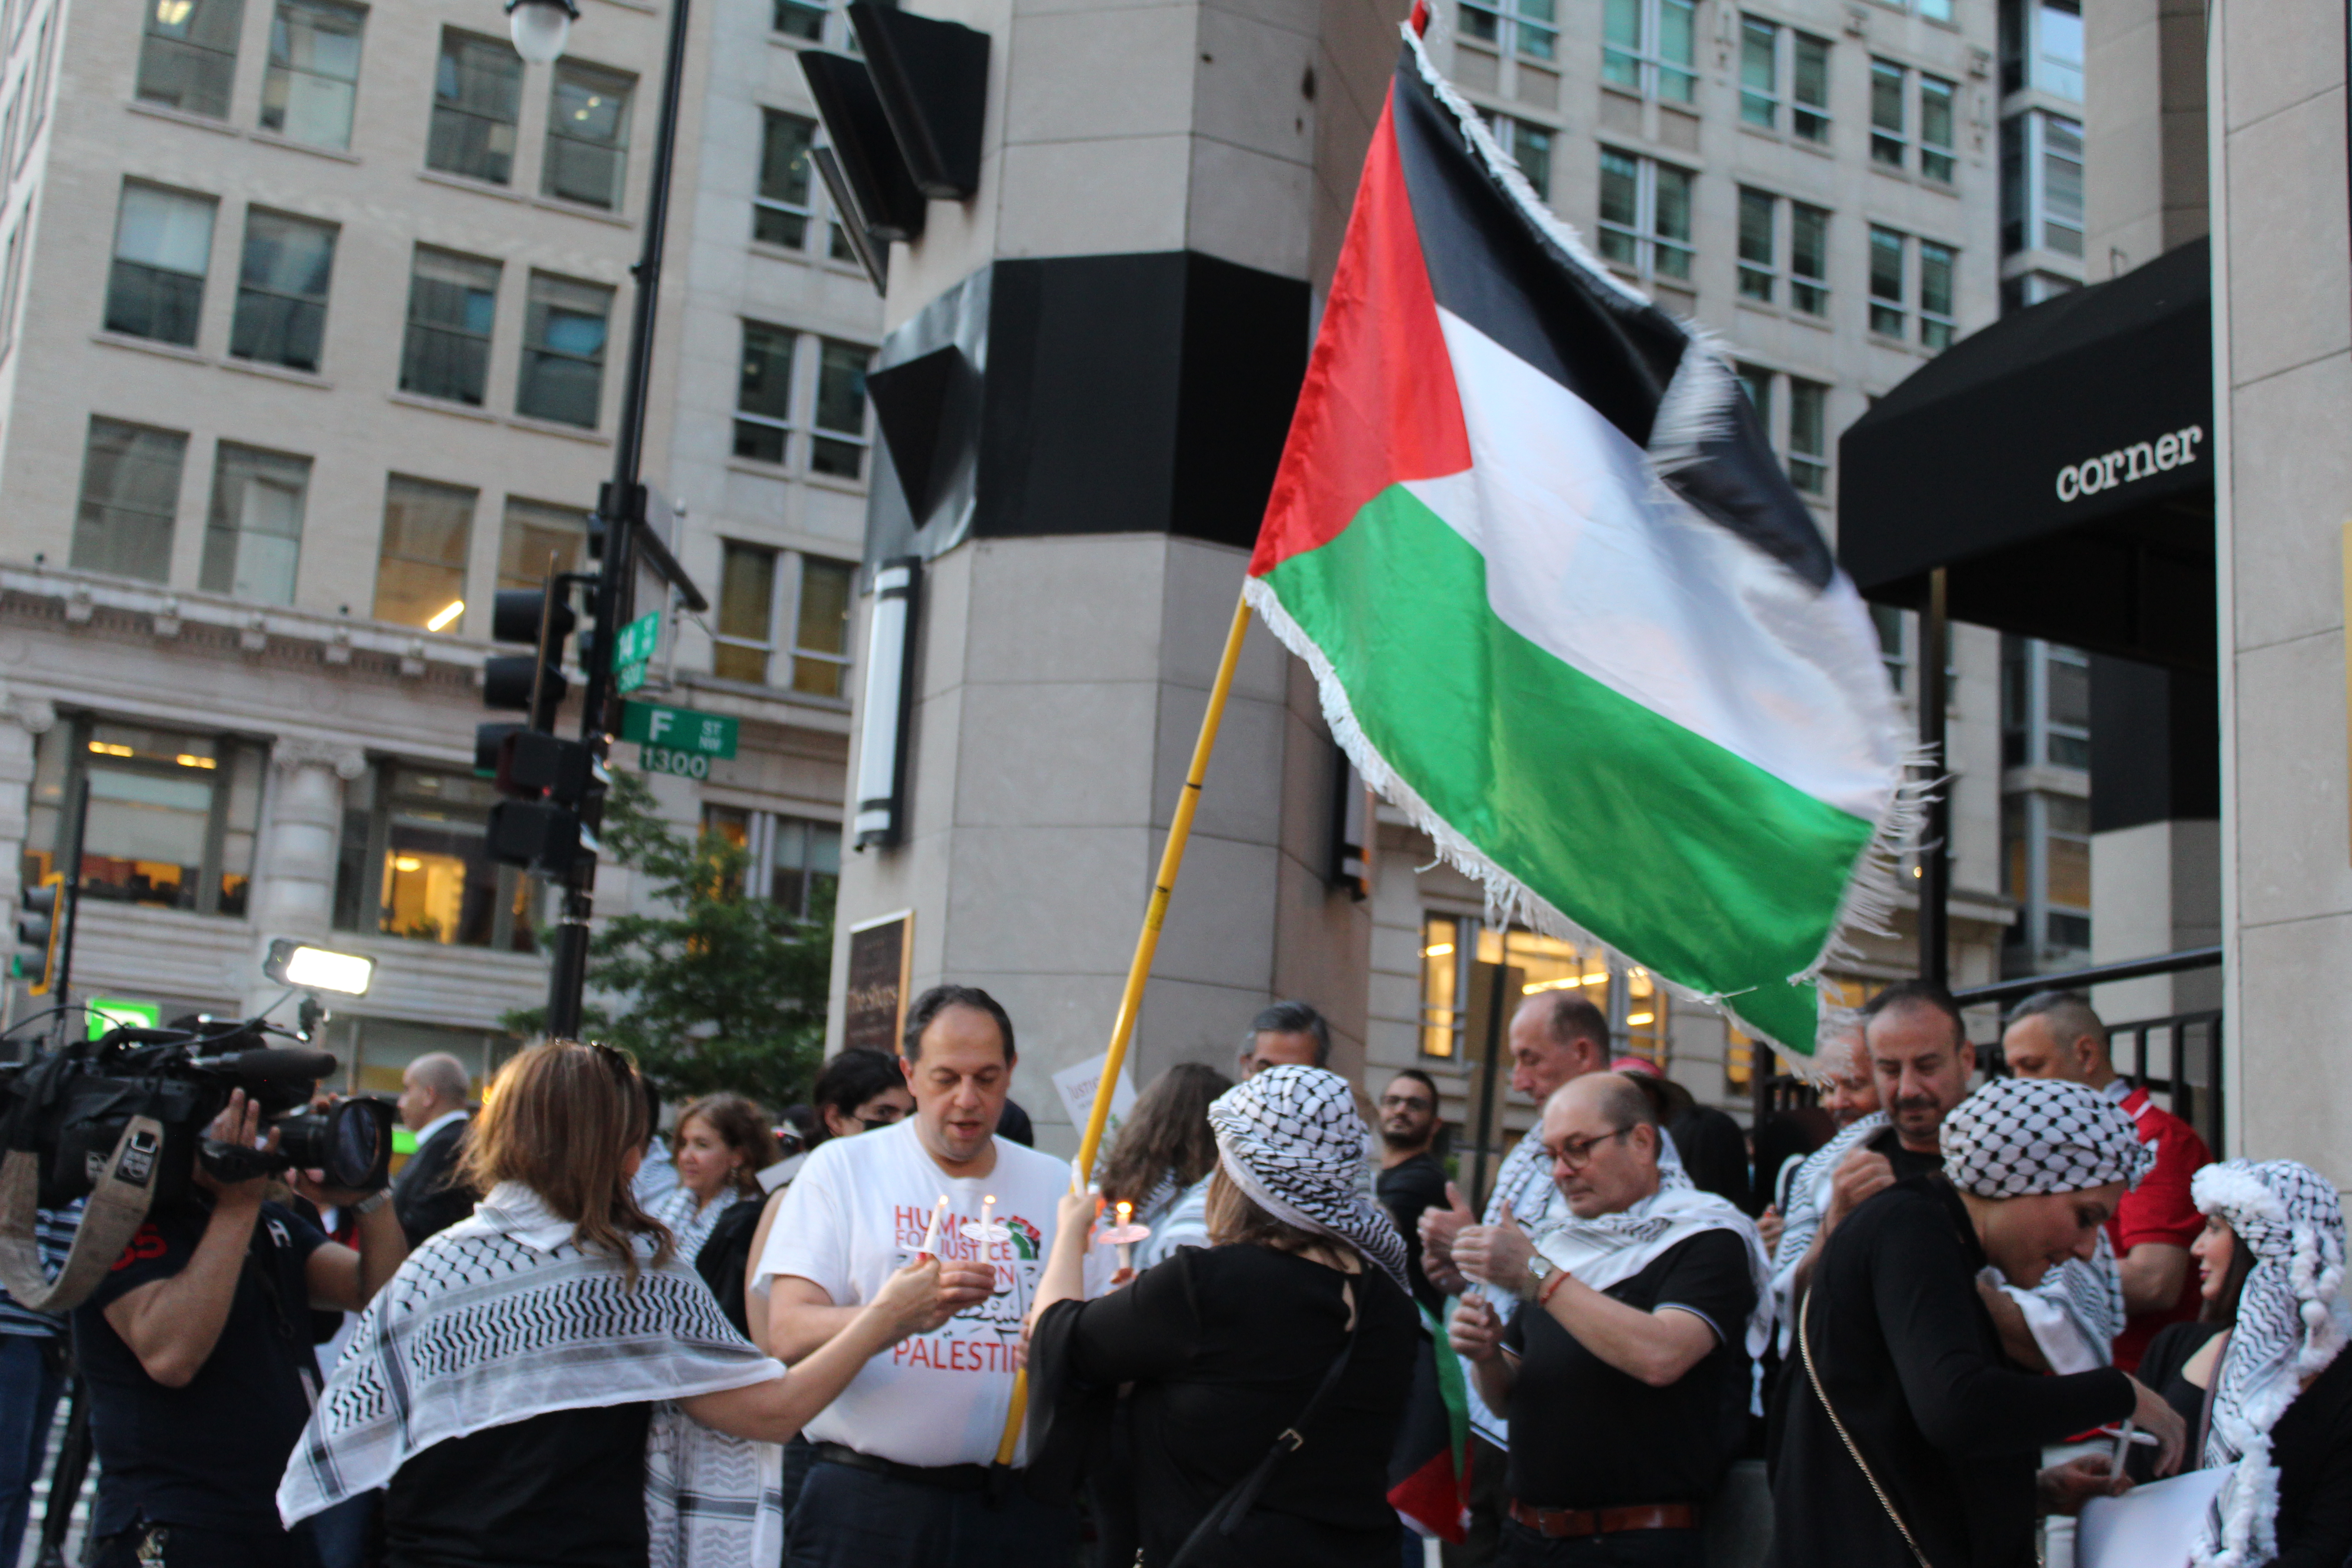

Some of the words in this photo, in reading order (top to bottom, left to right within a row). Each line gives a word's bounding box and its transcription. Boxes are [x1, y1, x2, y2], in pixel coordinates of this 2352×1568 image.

[2056, 424, 2203, 502] corner
[649, 710, 674, 742] F
[703, 720, 722, 736] ST
[699, 736, 722, 752] NW
[642, 748, 707, 777] 1300
[896, 1230, 927, 1247] FO
[940, 1239, 1012, 1262] JUSTCE
[894, 1338, 1017, 1373] PALESTI
